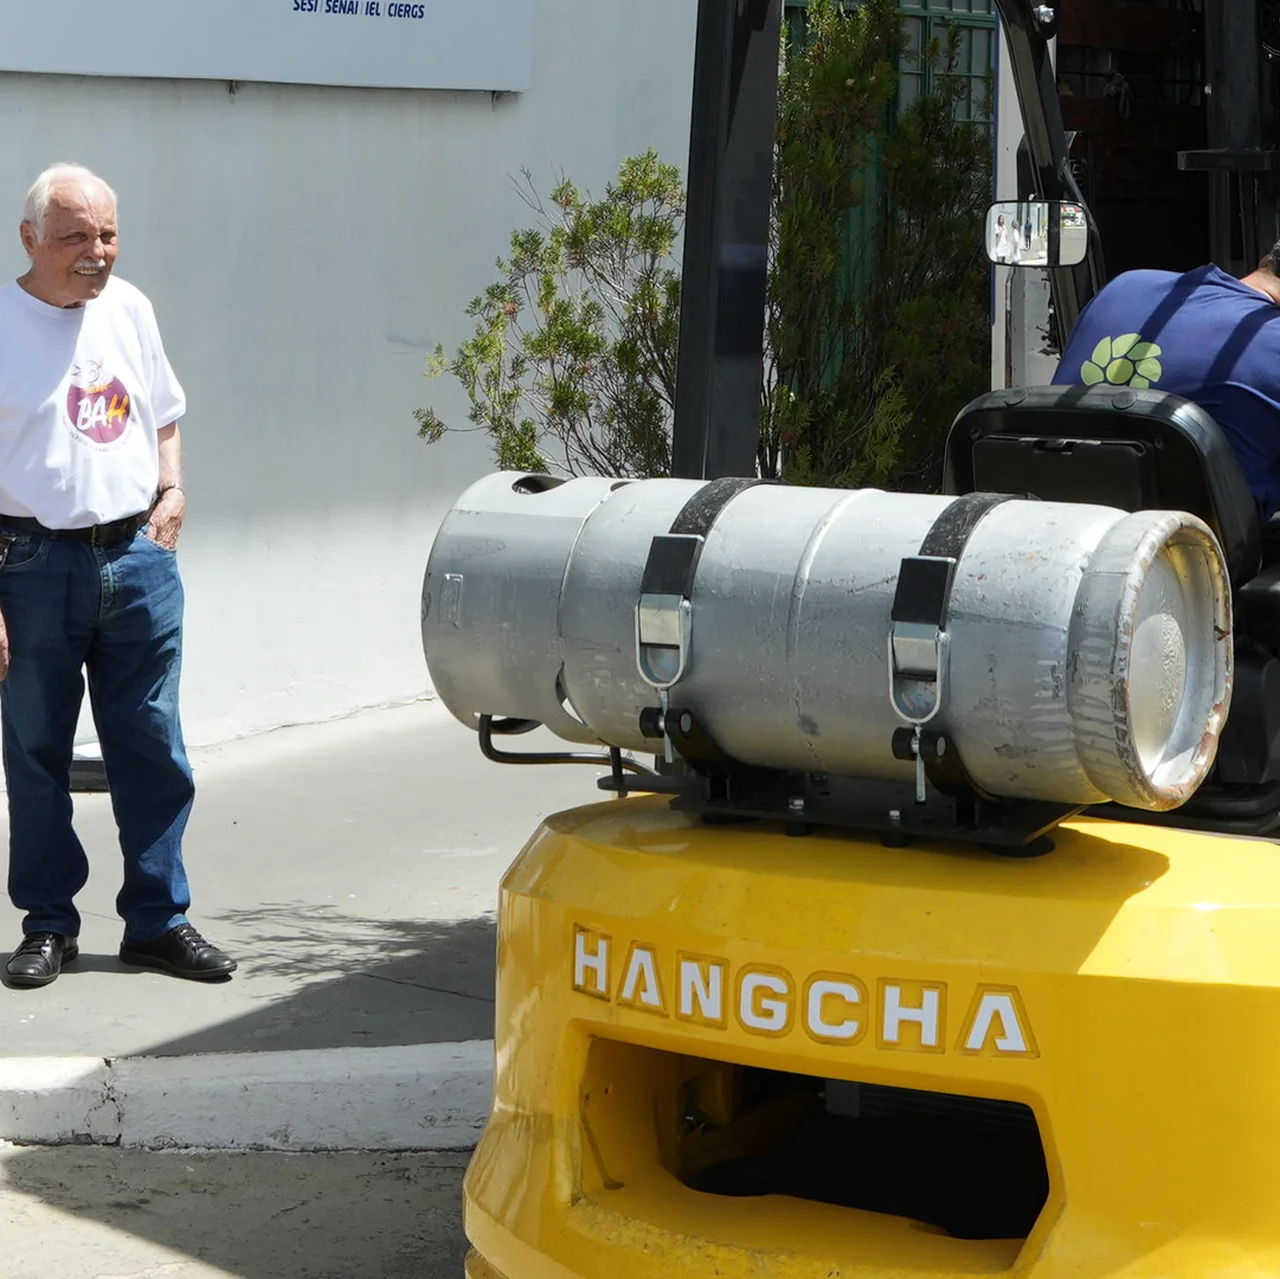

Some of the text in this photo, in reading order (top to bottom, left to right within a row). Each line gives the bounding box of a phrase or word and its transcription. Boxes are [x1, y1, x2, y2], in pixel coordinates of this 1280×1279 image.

[364, 0, 381, 17] IEL
[387, 2, 426, 20] CIERGS
[574, 931, 1027, 1053] HANGCHA
